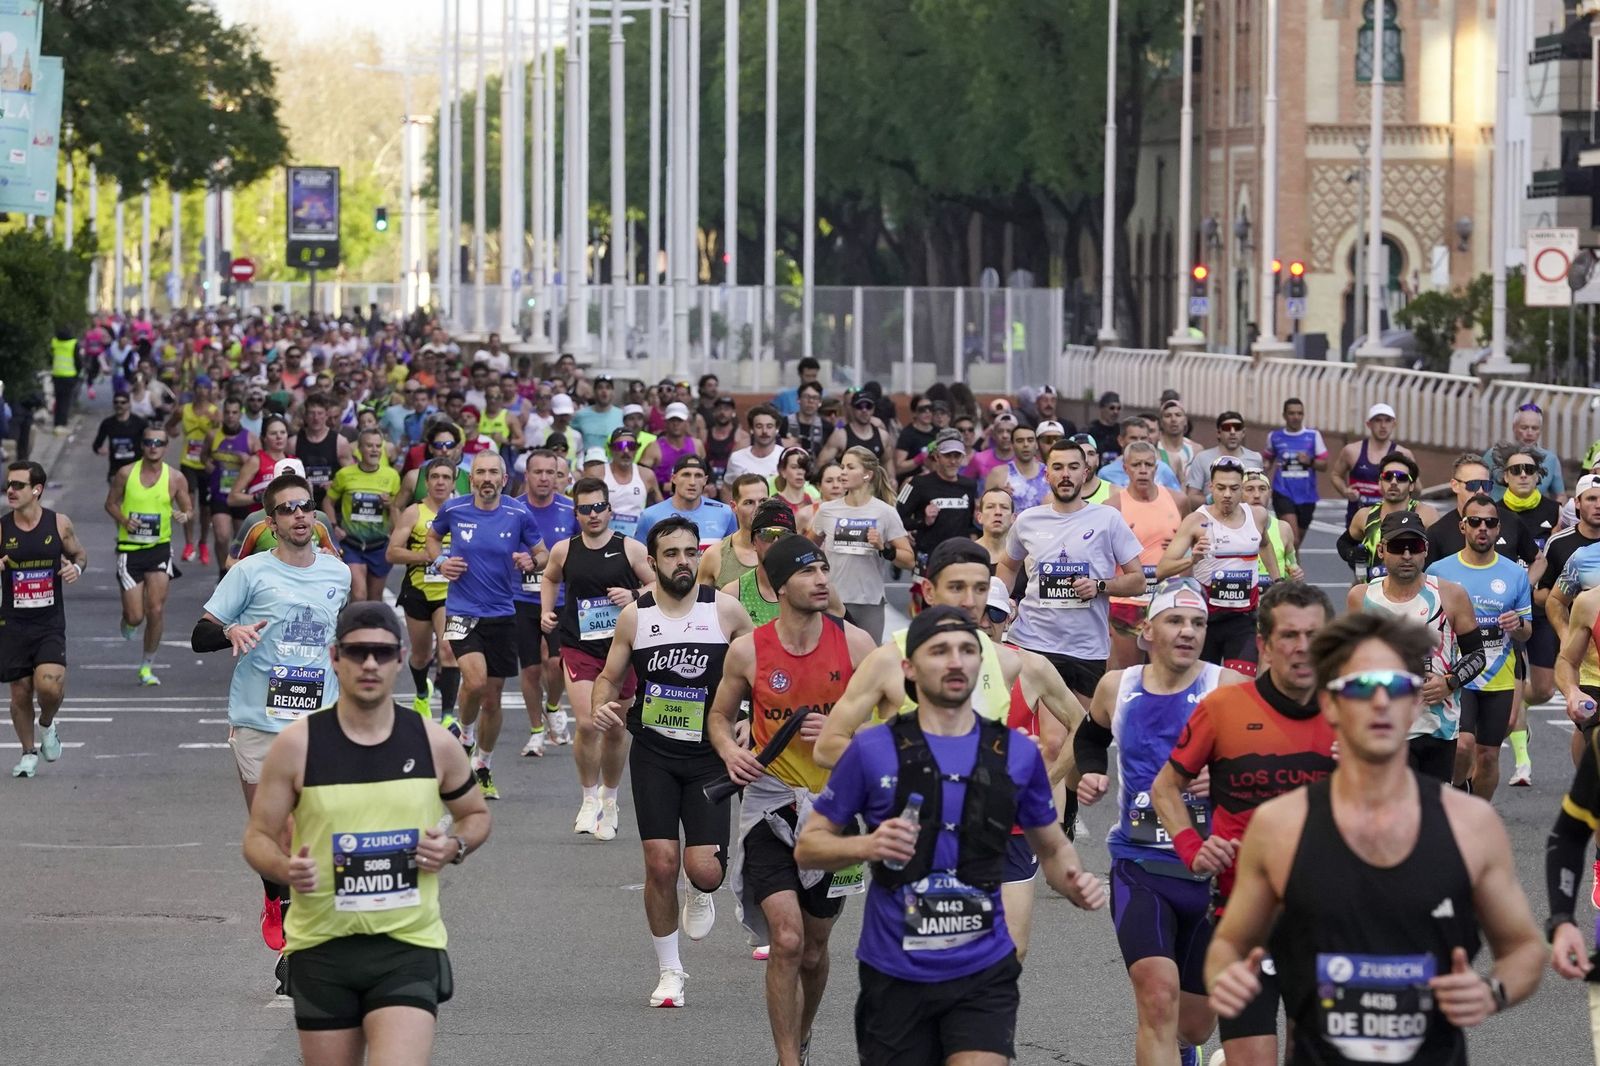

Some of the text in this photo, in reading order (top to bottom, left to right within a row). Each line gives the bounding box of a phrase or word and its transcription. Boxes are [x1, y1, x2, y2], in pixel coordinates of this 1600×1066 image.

[1055, 565, 1084, 573] ZURICH
[1226, 571, 1250, 579] ZURICH
[1218, 590, 1245, 600] PABLO
[1473, 595, 1504, 609] Training
[595, 611, 610, 619] 6114
[648, 648, 709, 672] delikia
[291, 669, 320, 679] ZURICH
[681, 666, 697, 675] fresh
[289, 685, 307, 694] 4990
[664, 688, 699, 700] ZURICH
[273, 694, 318, 709] REIXACH
[664, 704, 683, 713] 3346
[654, 713, 690, 728] JAIME
[1230, 769, 1270, 787] LOS
[361, 833, 411, 848] ZURICH
[364, 858, 392, 872] 5086
[343, 872, 411, 893] DAVID L.
[832, 874, 853, 886] RUN
[935, 900, 964, 913] 4143
[916, 914, 983, 935] JANNES
[1358, 961, 1424, 979] ZURICH
[1327, 1012, 1427, 1037] DE DIEGO
